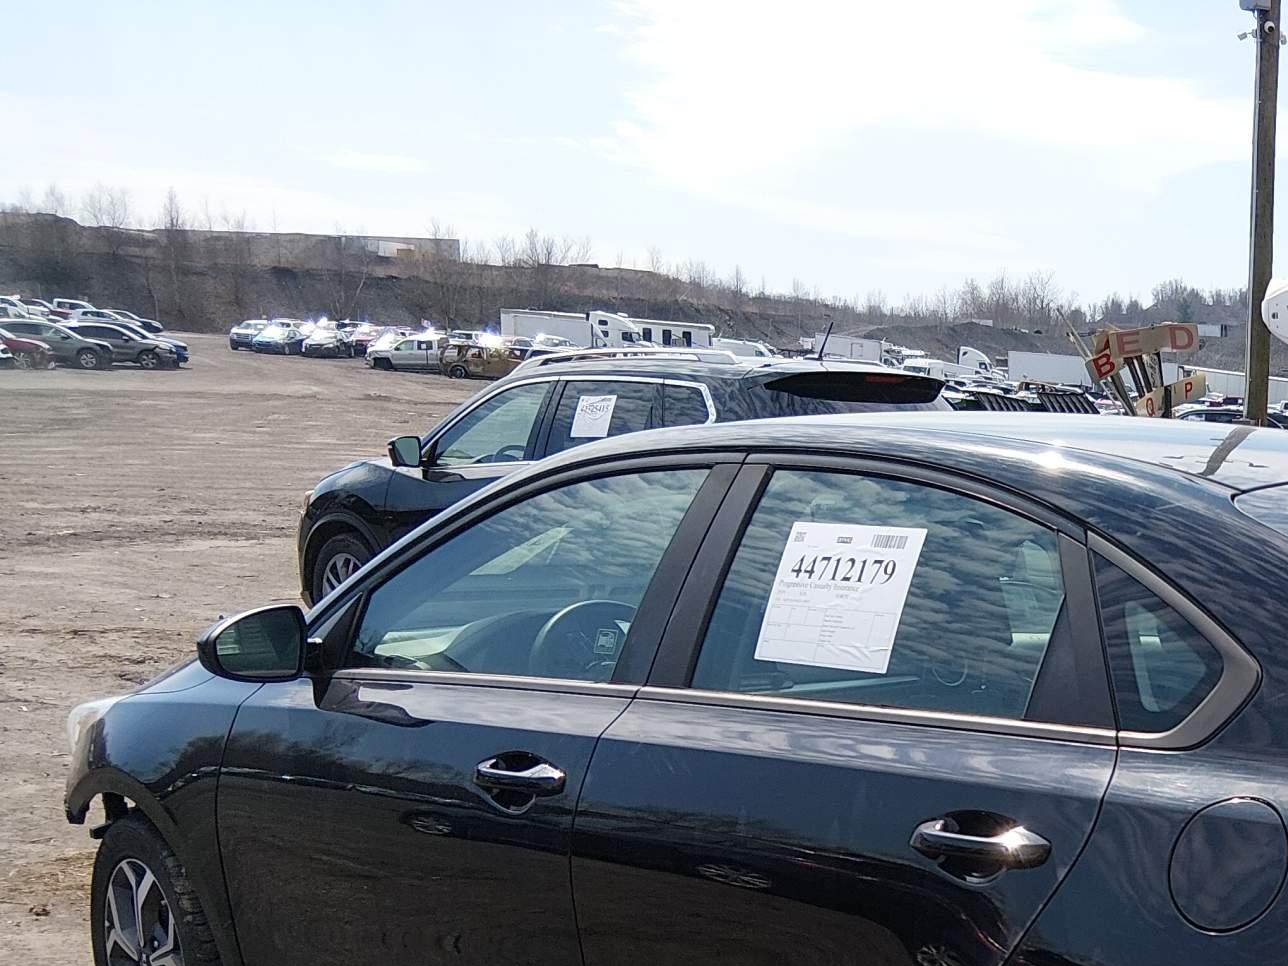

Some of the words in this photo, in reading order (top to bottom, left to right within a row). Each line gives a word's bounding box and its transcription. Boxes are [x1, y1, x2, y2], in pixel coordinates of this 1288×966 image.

[1116, 331, 1141, 354] E
[1168, 326, 1194, 350] D
[1092, 352, 1116, 378] B
[1184, 381, 1193, 400] P
[791, 554, 897, 585] 44712179
